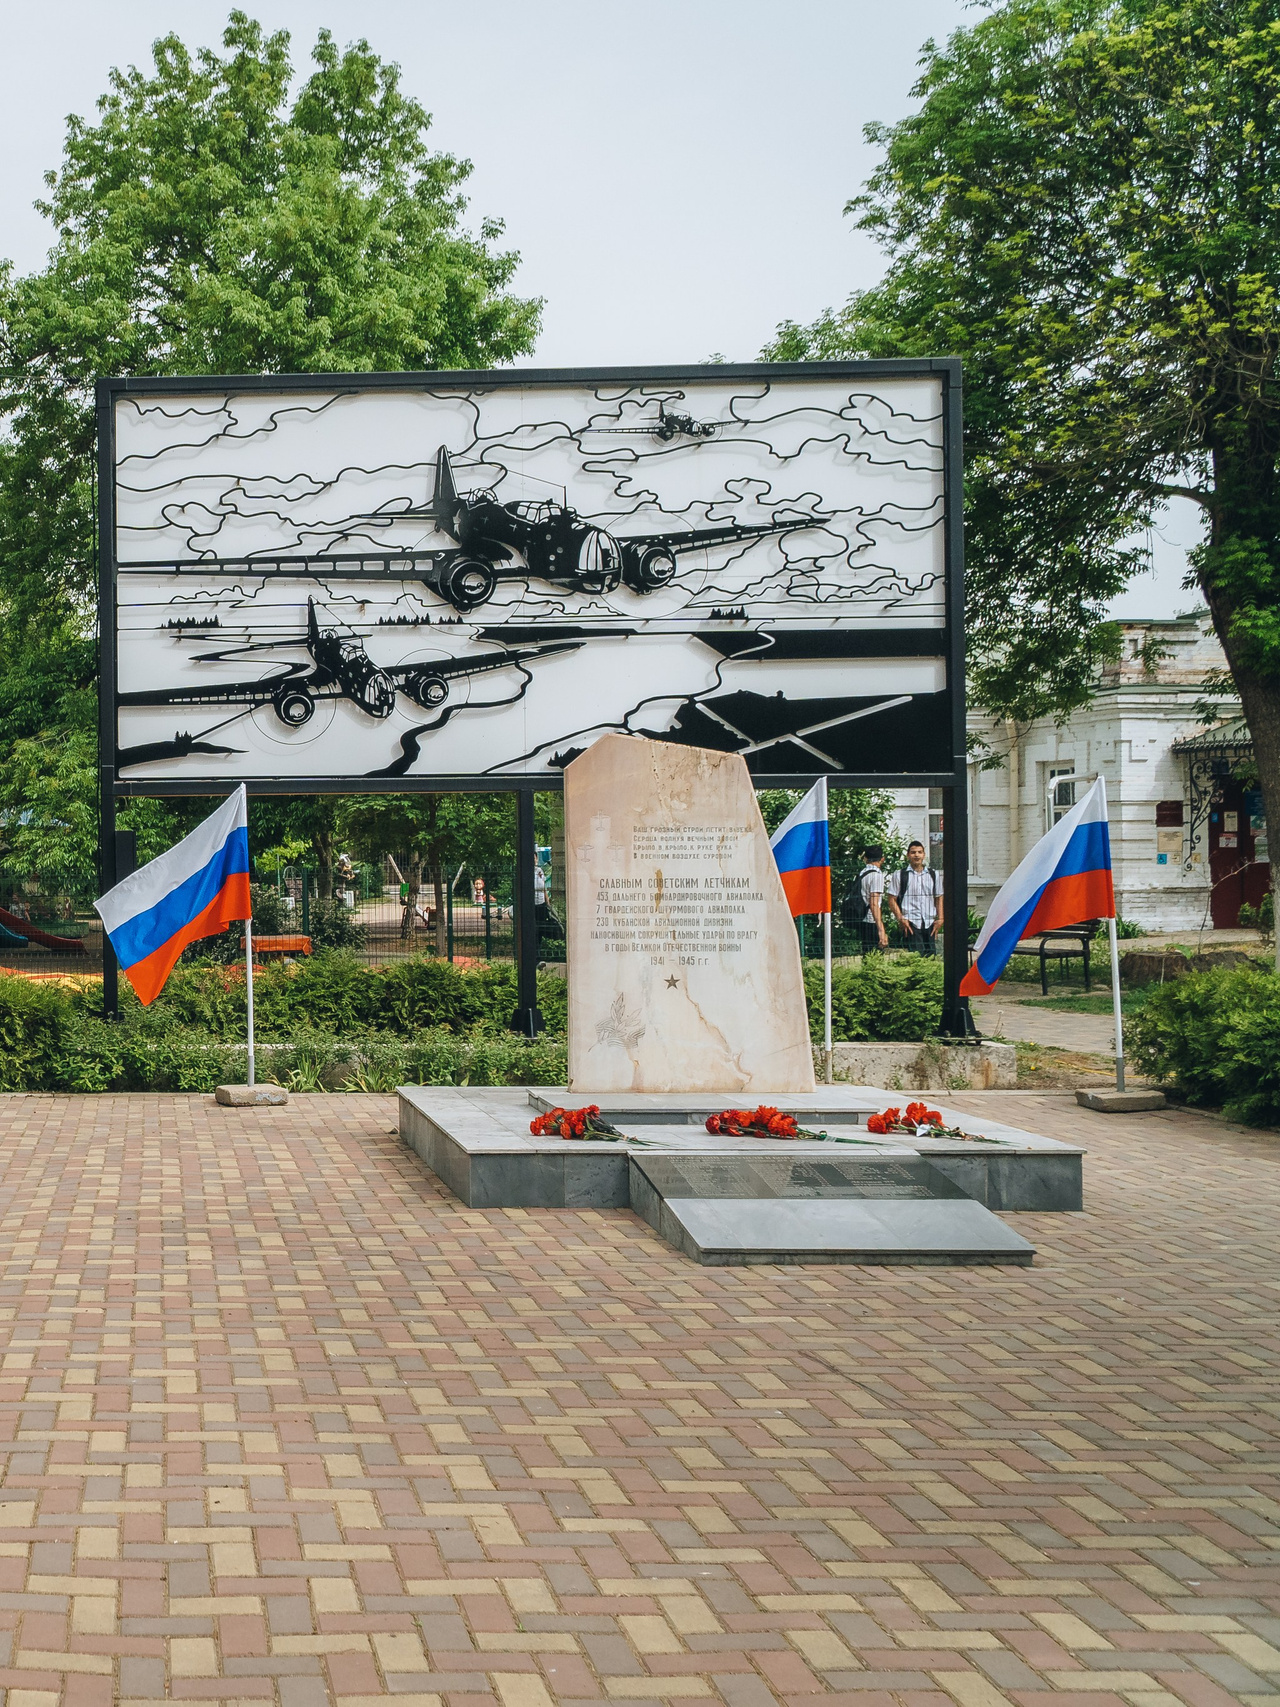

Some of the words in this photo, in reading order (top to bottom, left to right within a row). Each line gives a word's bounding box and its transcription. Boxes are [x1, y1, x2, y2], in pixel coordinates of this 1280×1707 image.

[600, 879, 642, 888] СЛАВНЫМ
[648, 878, 698, 888] СОВЕТСКИМ
[704, 878, 750, 888] ЛЕТЧИКАМ
[597, 892, 608, 901] 453
[613, 893, 646, 901] ДАЛЬНЕГО
[650, 893, 722, 901] БОМБАРДИРОВОЧНОГО
[726, 892, 763, 901] АВИАПОЛКА
[596, 905, 600, 913] 7
[659, 905, 704, 914] ШТУРМОВОГО
[596, 917, 609, 926] 230
[591, 931, 635, 939] НАНОСИВШИМ
[702, 931, 724, 939] УДАРЫ
[726, 931, 735, 939] ПО
[737, 931, 758, 939] ВРАГУ
[651, 956, 664, 965] 1941
[679, 956, 695, 965] 1945
